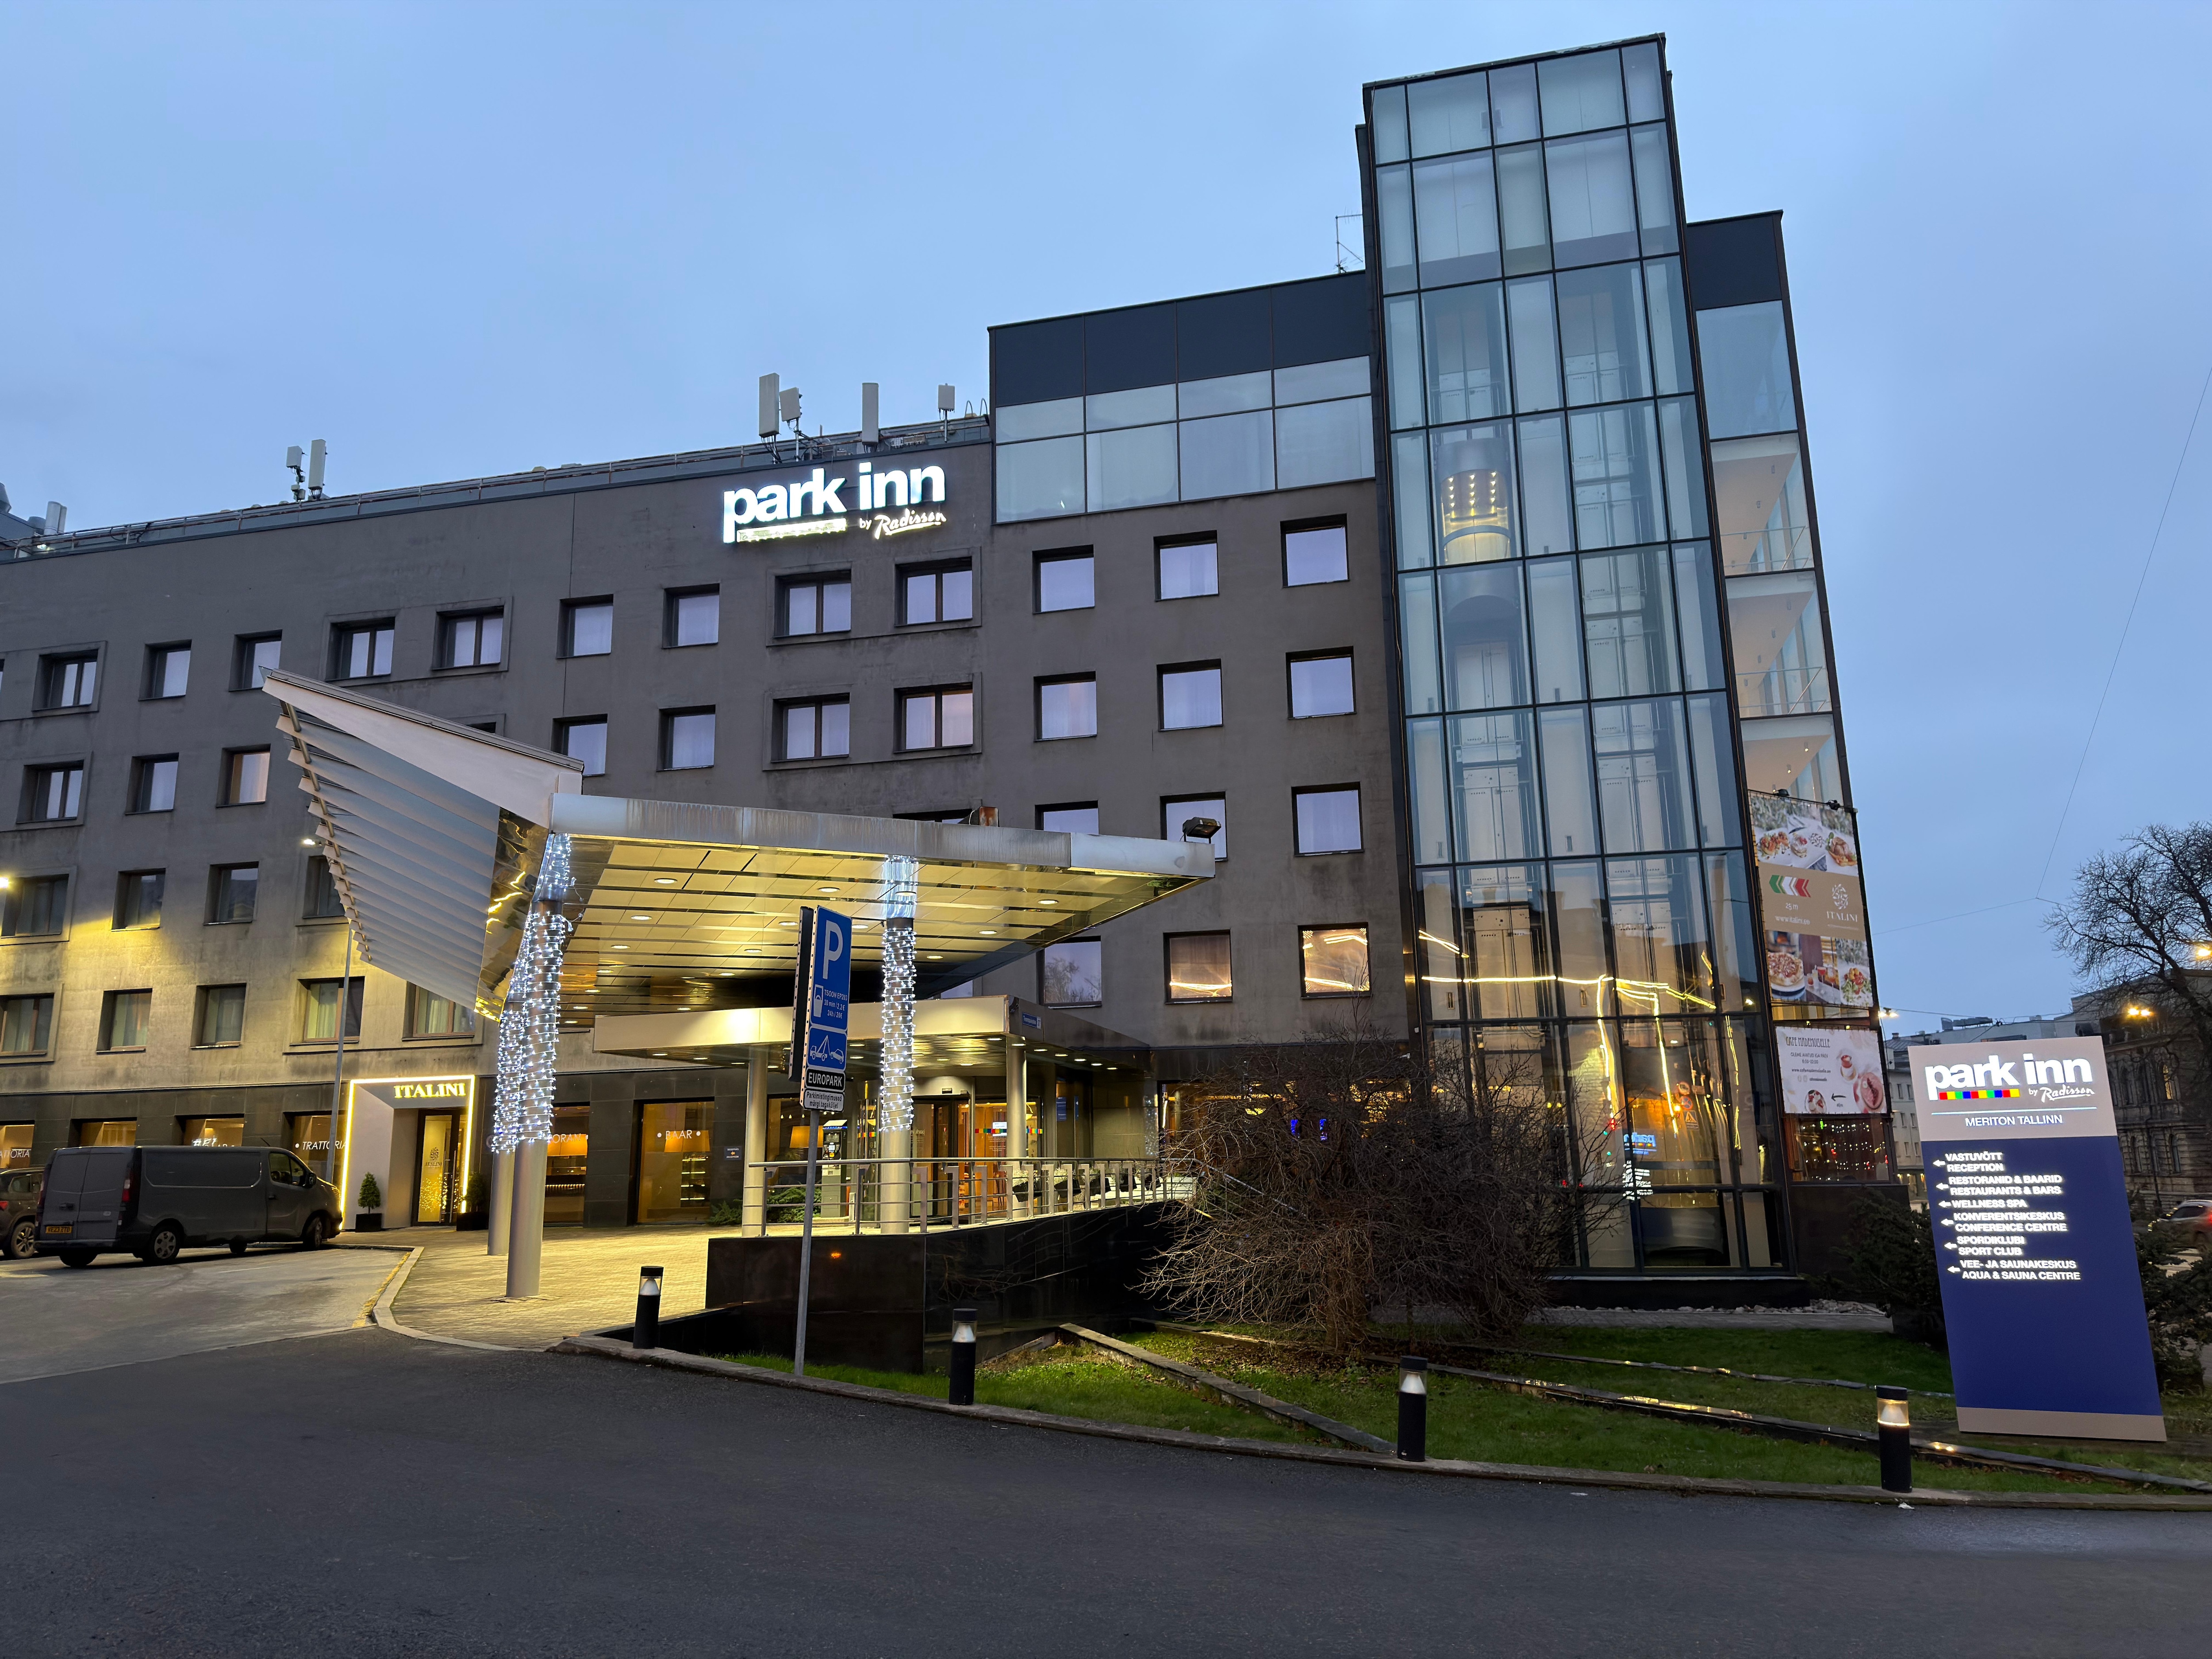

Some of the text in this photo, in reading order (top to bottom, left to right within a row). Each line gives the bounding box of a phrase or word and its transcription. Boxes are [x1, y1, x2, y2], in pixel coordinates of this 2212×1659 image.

[723, 462, 945, 543] park inn
[860, 508, 947, 540] by Radisson
[1775, 915, 1810, 925] www.italini.ee
[1827, 911, 1858, 922] ITALINI
[823, 920, 843, 979] P
[824, 989, 837, 998] TSOON
[1786, 1037, 1830, 1048] CAFE MADEMOISELLE
[808, 1072, 842, 1087] EUROPARK
[1925, 1053, 2093, 1100] park inn
[394, 1083, 466, 1098] ITALINI
[2038, 1084, 2095, 1102] Radisson
[806, 1091, 842, 1102] Parkimistingimused
[821, 1101, 838, 1110] tagaküljel
[1965, 1115, 2063, 1126] MERITON TALLINN
[665, 1130, 692, 1139] BAAR
[1945, 1151, 2003, 1161] VASTUVÕTT
[1947, 1163, 2004, 1172] RECEPTION
[1949, 1176, 2012, 1184] RESTORANID
[2023, 1175, 2062, 1183] BAARID
[1950, 1187, 2023, 1195] RESTAURANTS
[2033, 1186, 2062, 1194] BARS
[1952, 1199, 2006, 1208] WELLNESS
[1954, 1212, 2065, 1221] KONVERENTSIKESKUS
[1955, 1223, 2067, 1232] CONFERENCE CENTRE
[1957, 1236, 2025, 1244] SPORDIKLUBI
[1959, 1247, 2022, 1256] SPORT CLUB
[1960, 1260, 2076, 1269] VEE- JA SAUNAKESKUS
[1962, 1271, 2081, 1280] AQUA & SAUNA CENTRE
